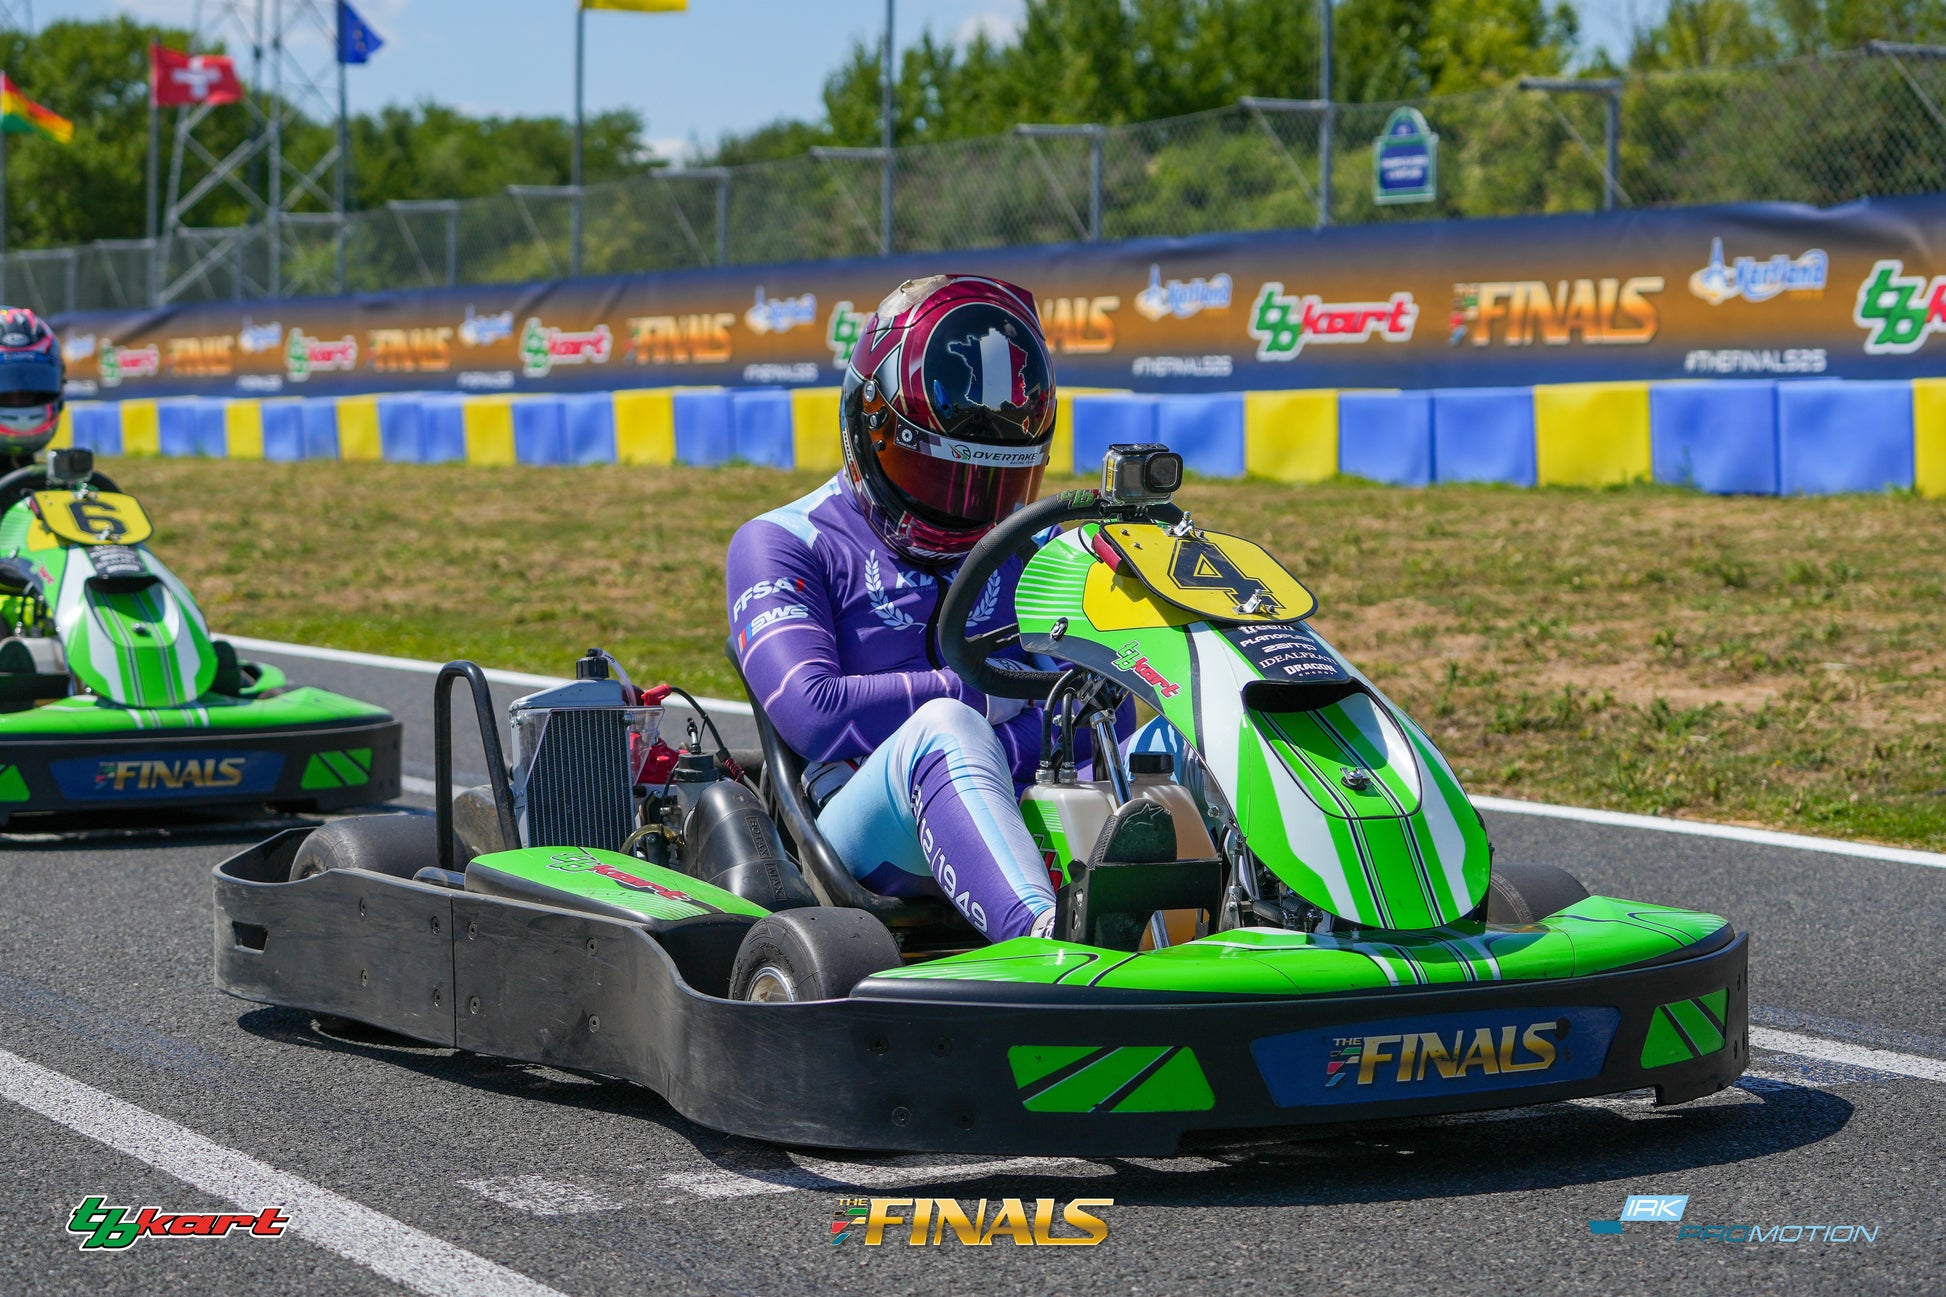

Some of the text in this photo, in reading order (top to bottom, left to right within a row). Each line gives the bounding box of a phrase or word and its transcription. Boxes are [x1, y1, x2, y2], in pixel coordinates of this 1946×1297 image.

[1472, 276, 1665, 347] FINALS
[973, 451, 1038, 461] OVERTAKE
[66, 500, 128, 536] 6
[1168, 539, 1286, 611] 4
[733, 577, 796, 623] FFSA
[751, 603, 809, 637] SWS
[1258, 651, 1338, 669] IDEALPRATI
[1283, 663, 1338, 676] DRAGON
[113, 757, 246, 791] FINALS
[1332, 1021, 1557, 1085] THE FINALS
